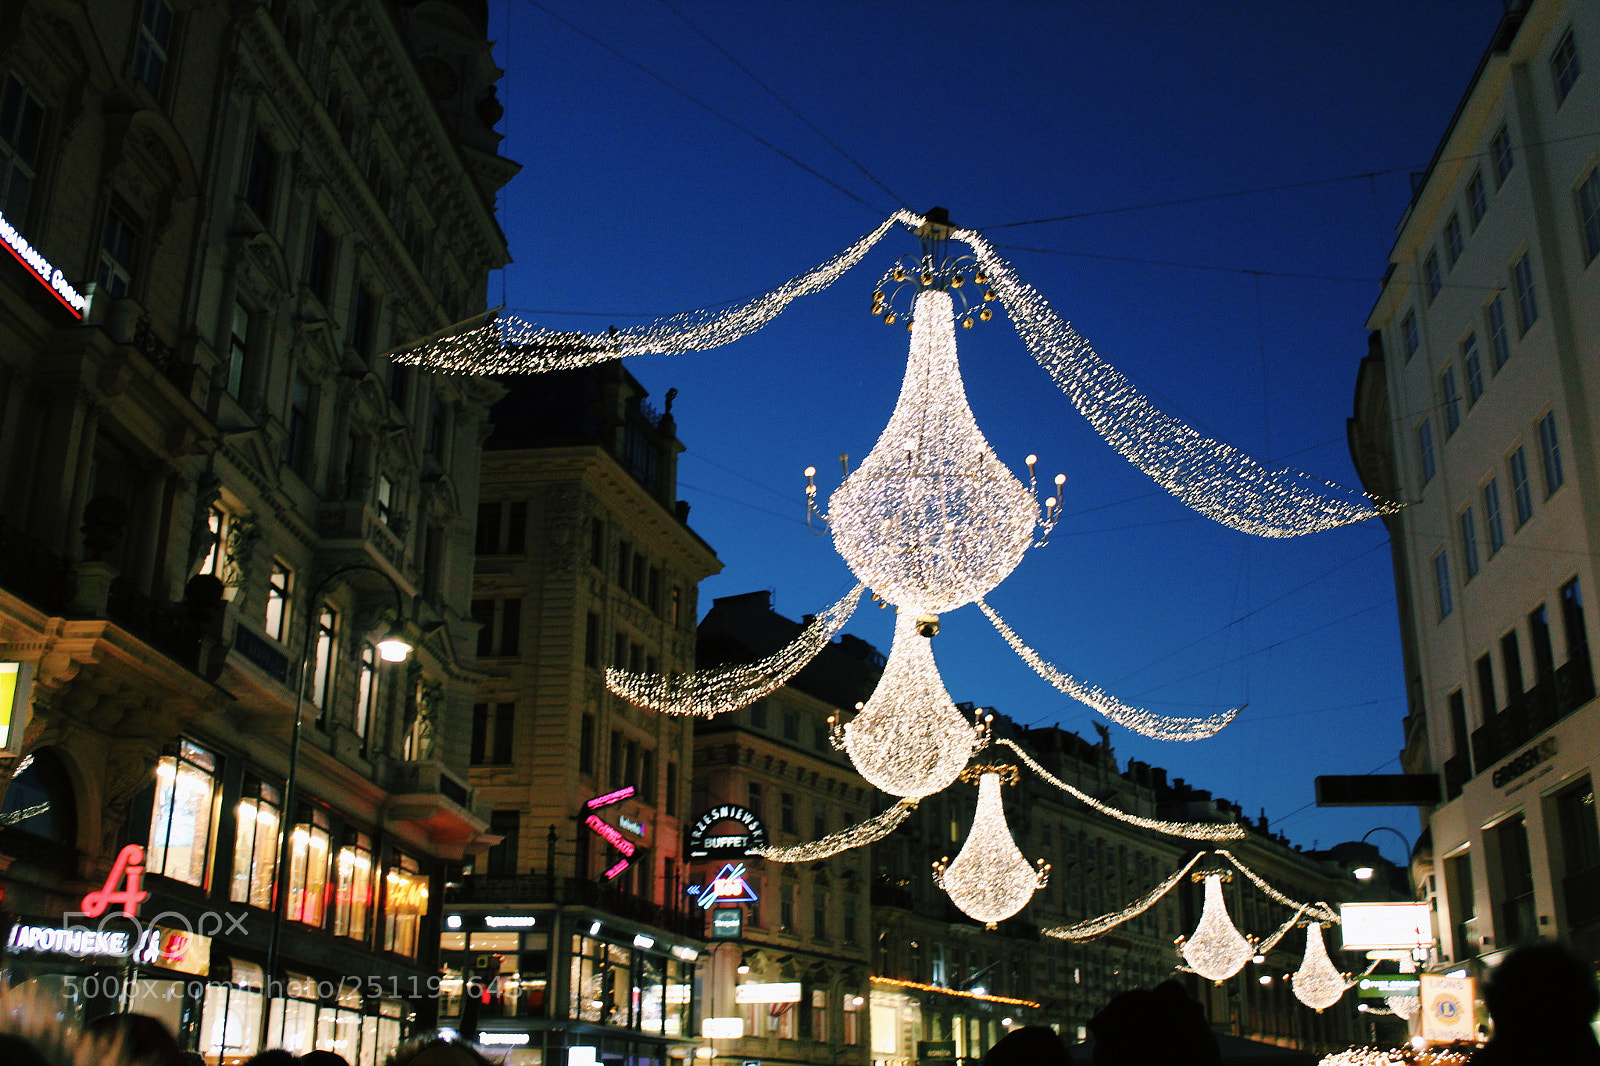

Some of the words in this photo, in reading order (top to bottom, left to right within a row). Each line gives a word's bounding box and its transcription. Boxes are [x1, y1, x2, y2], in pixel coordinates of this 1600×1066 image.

[0, 211, 53, 281] NSURANCE
[704, 836, 749, 849] BUFFET
[17, 926, 126, 953] APOTHEKE
